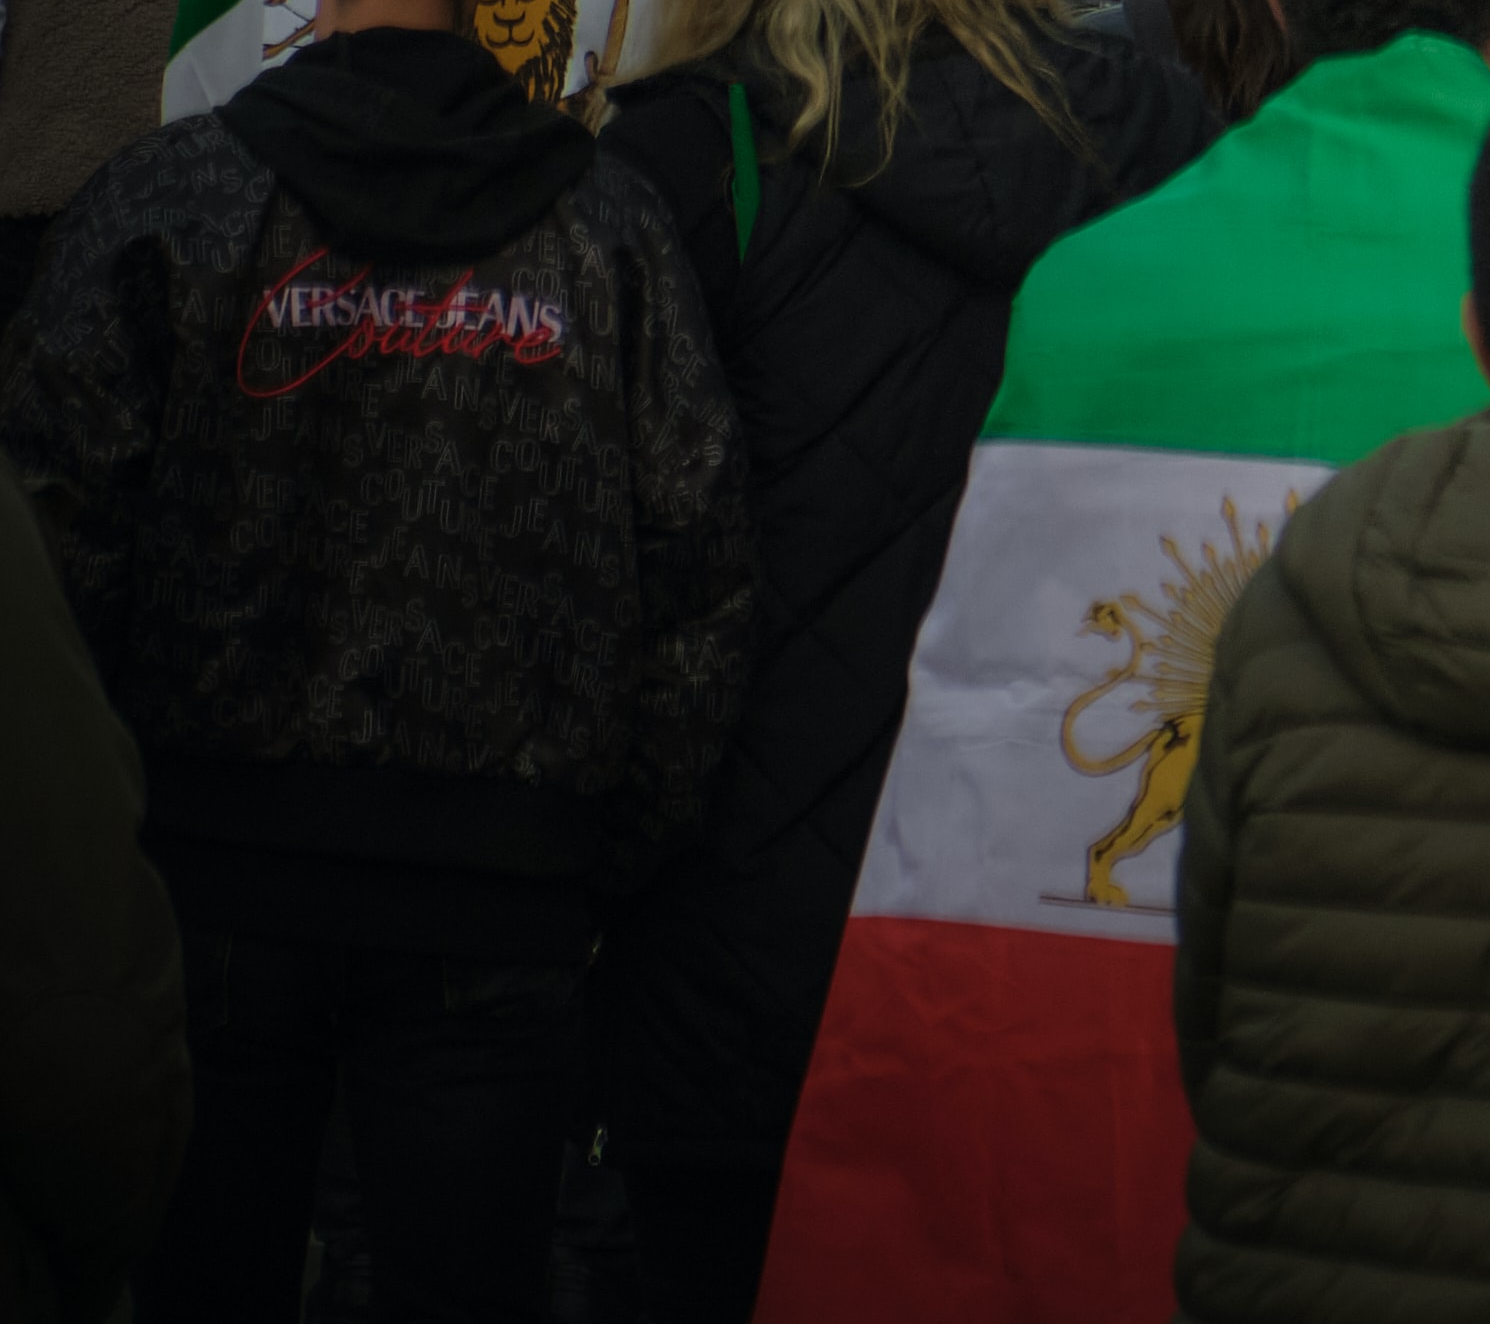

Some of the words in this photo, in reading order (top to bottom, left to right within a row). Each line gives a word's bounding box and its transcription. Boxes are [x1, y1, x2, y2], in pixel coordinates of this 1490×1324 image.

[237, 244, 562, 398] Couture
[263, 284, 426, 329] VERSACE
[436, 286, 564, 343] JEANS
